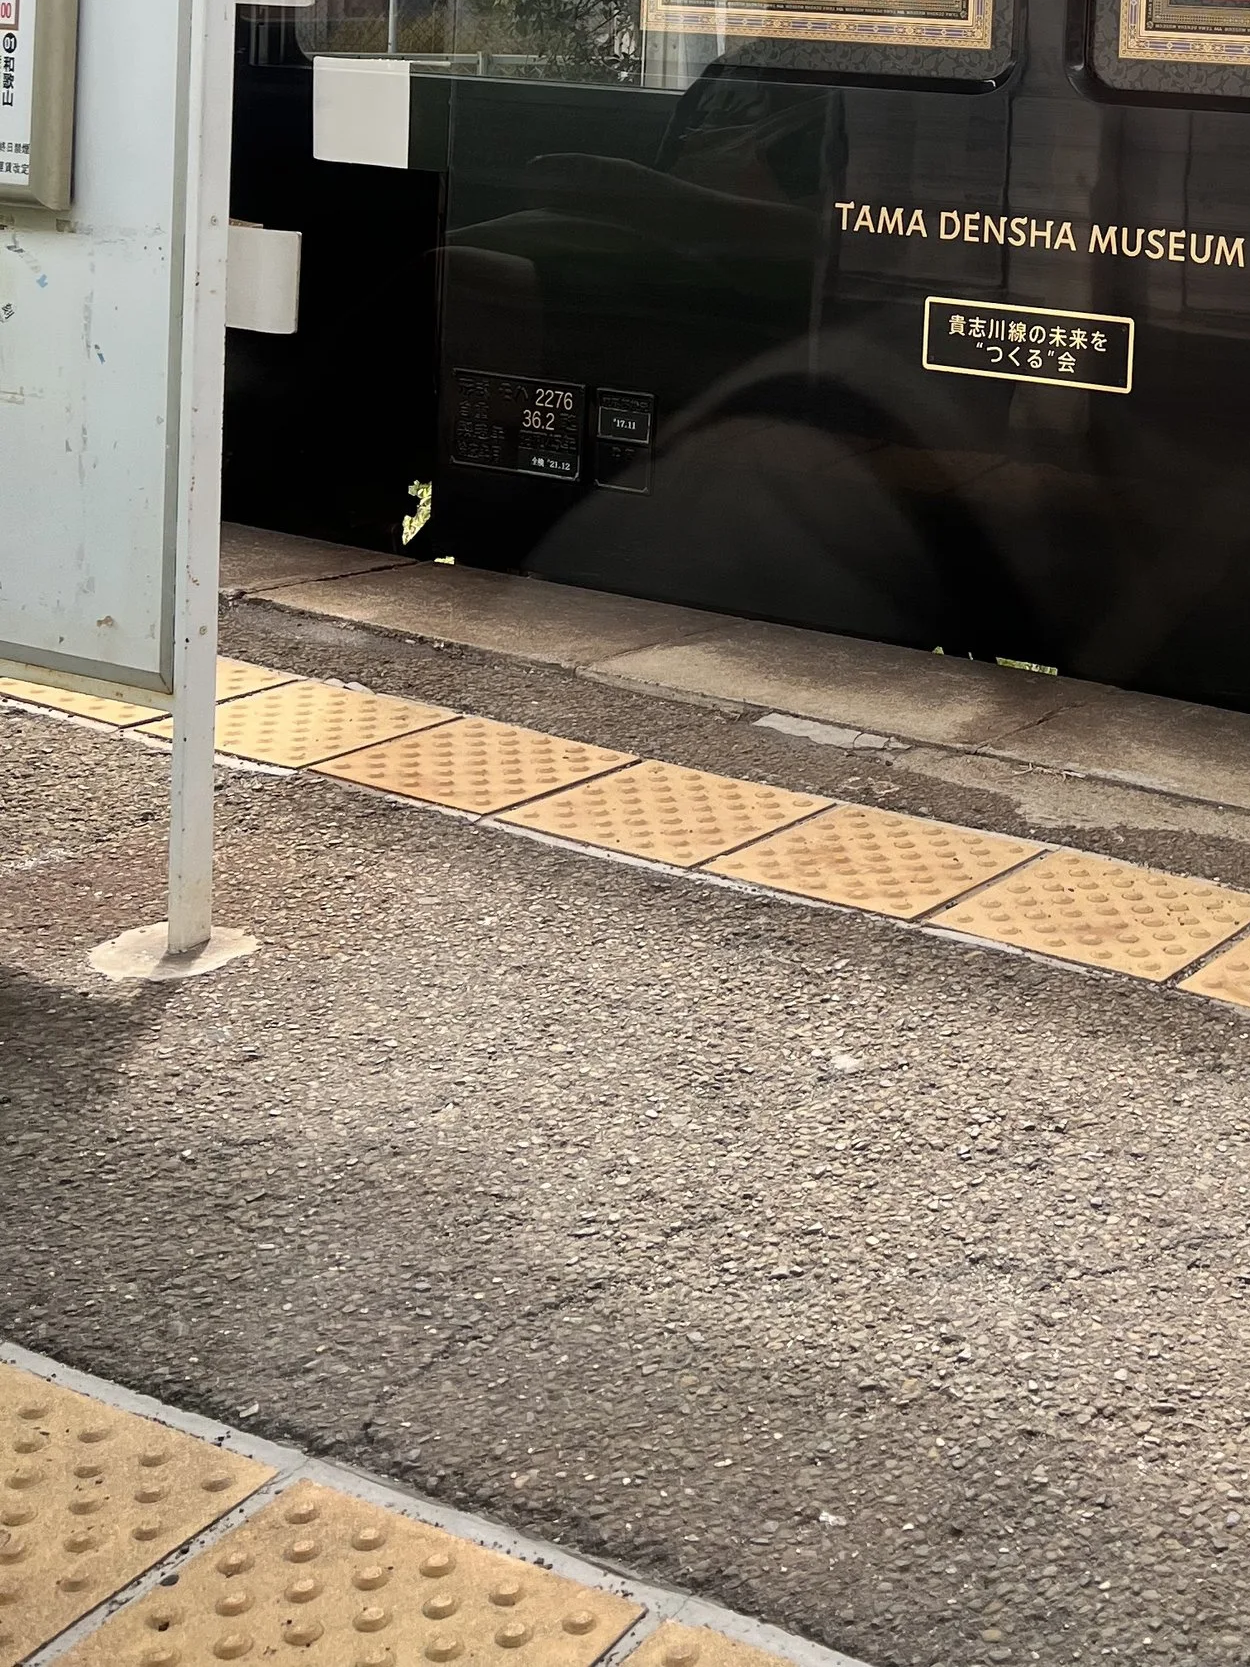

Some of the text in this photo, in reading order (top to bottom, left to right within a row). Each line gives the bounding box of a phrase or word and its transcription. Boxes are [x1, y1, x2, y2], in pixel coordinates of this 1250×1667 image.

[3, 56, 15, 107] 和歌山
[834, 201, 1246, 268] TAMA DENSHA MUSEUM
[948, 314, 1108, 352] 貴志川線の未来を
[535, 388, 573, 411] 2276
[522, 409, 555, 431] 36.2
